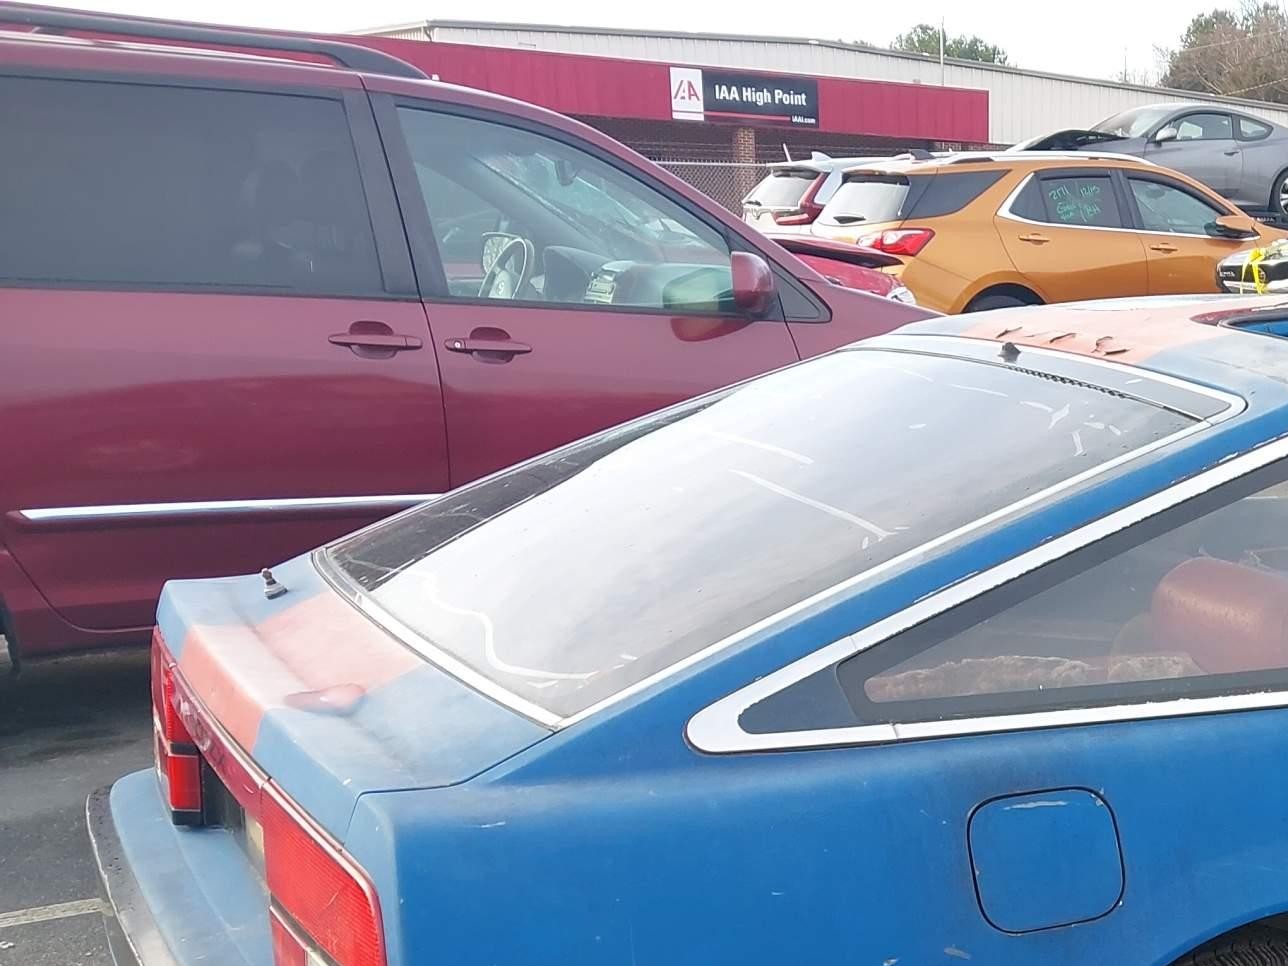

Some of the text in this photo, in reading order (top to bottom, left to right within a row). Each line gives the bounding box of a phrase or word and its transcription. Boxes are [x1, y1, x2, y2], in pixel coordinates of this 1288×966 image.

[715, 84, 807, 106] IAA High Point
